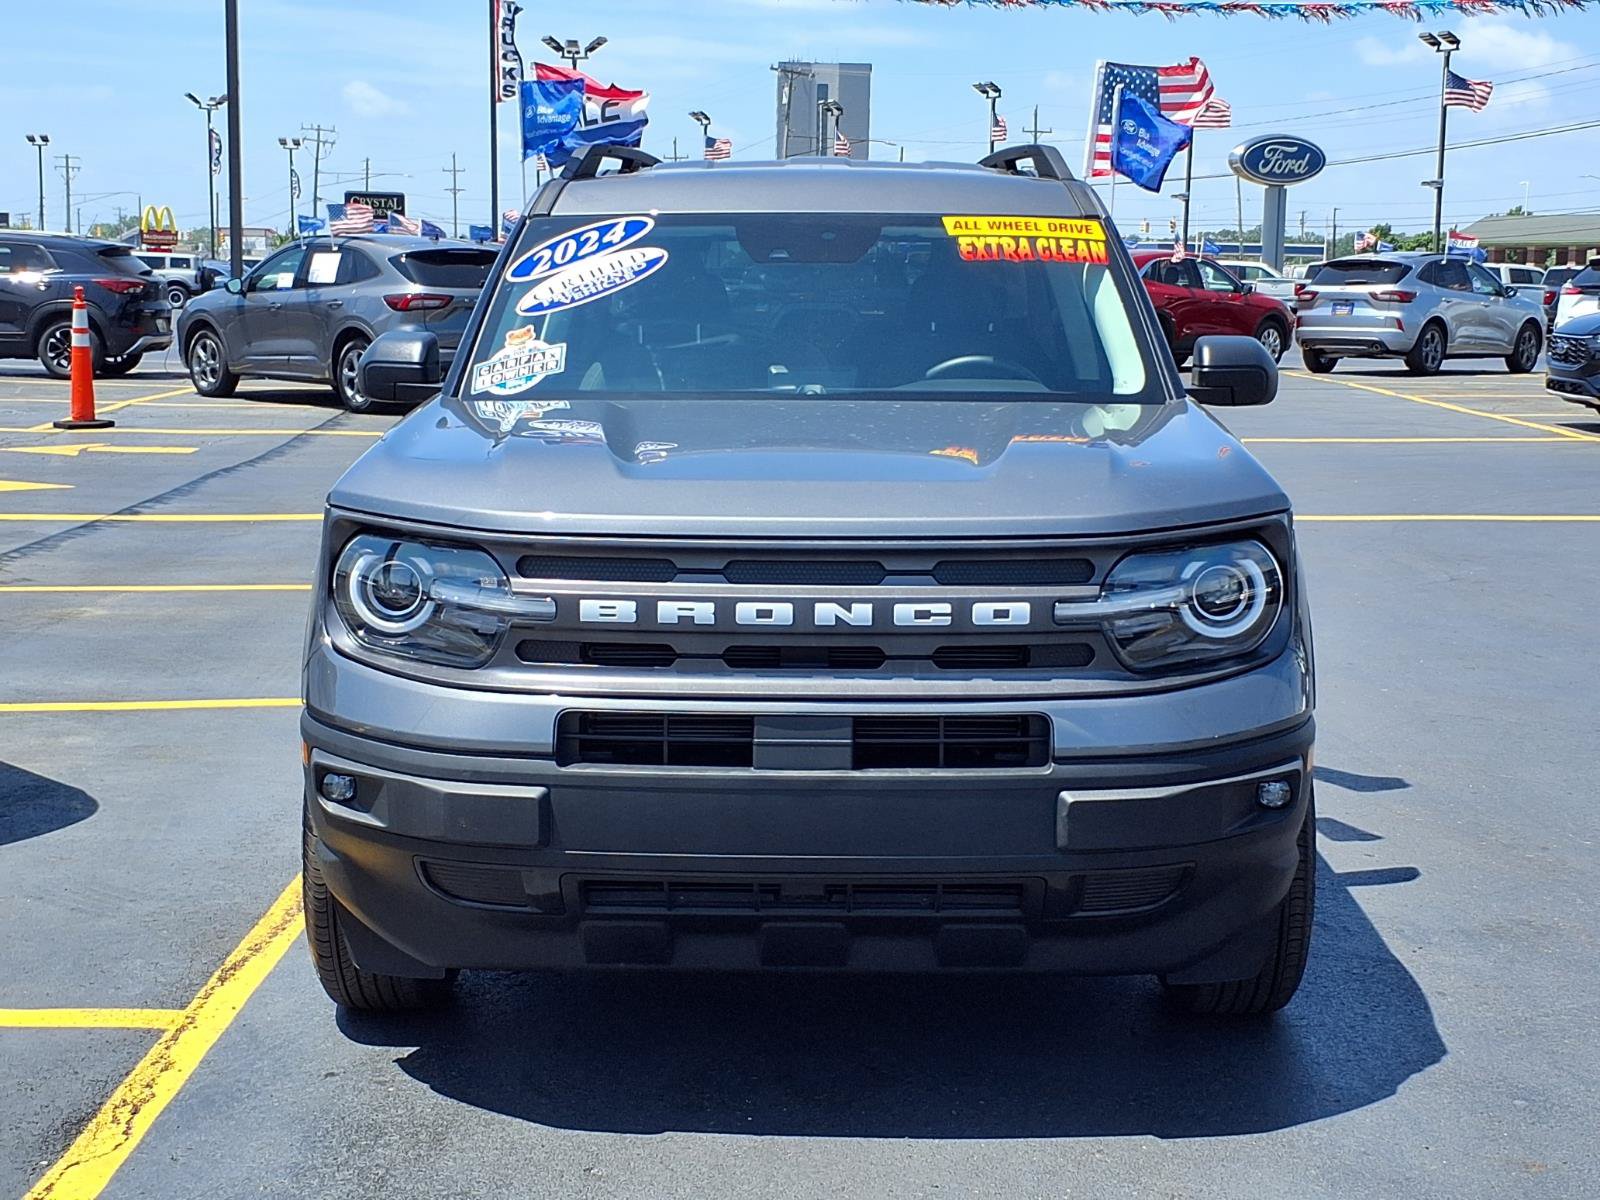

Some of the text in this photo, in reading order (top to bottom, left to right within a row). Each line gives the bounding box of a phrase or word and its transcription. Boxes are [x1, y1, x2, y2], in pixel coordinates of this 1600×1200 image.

[502, 1, 518, 98] TRUCKS
[578, 97, 621, 127] LE
[1258, 145, 1310, 174] Ford
[350, 196, 402, 210] CRYSTAL
[953, 220, 1094, 234] ALL WHEEL DRIVE
[530, 220, 627, 276] 2024
[957, 236, 1109, 265] EXTRA CLEAN
[579, 601, 1031, 626] BRONCO
